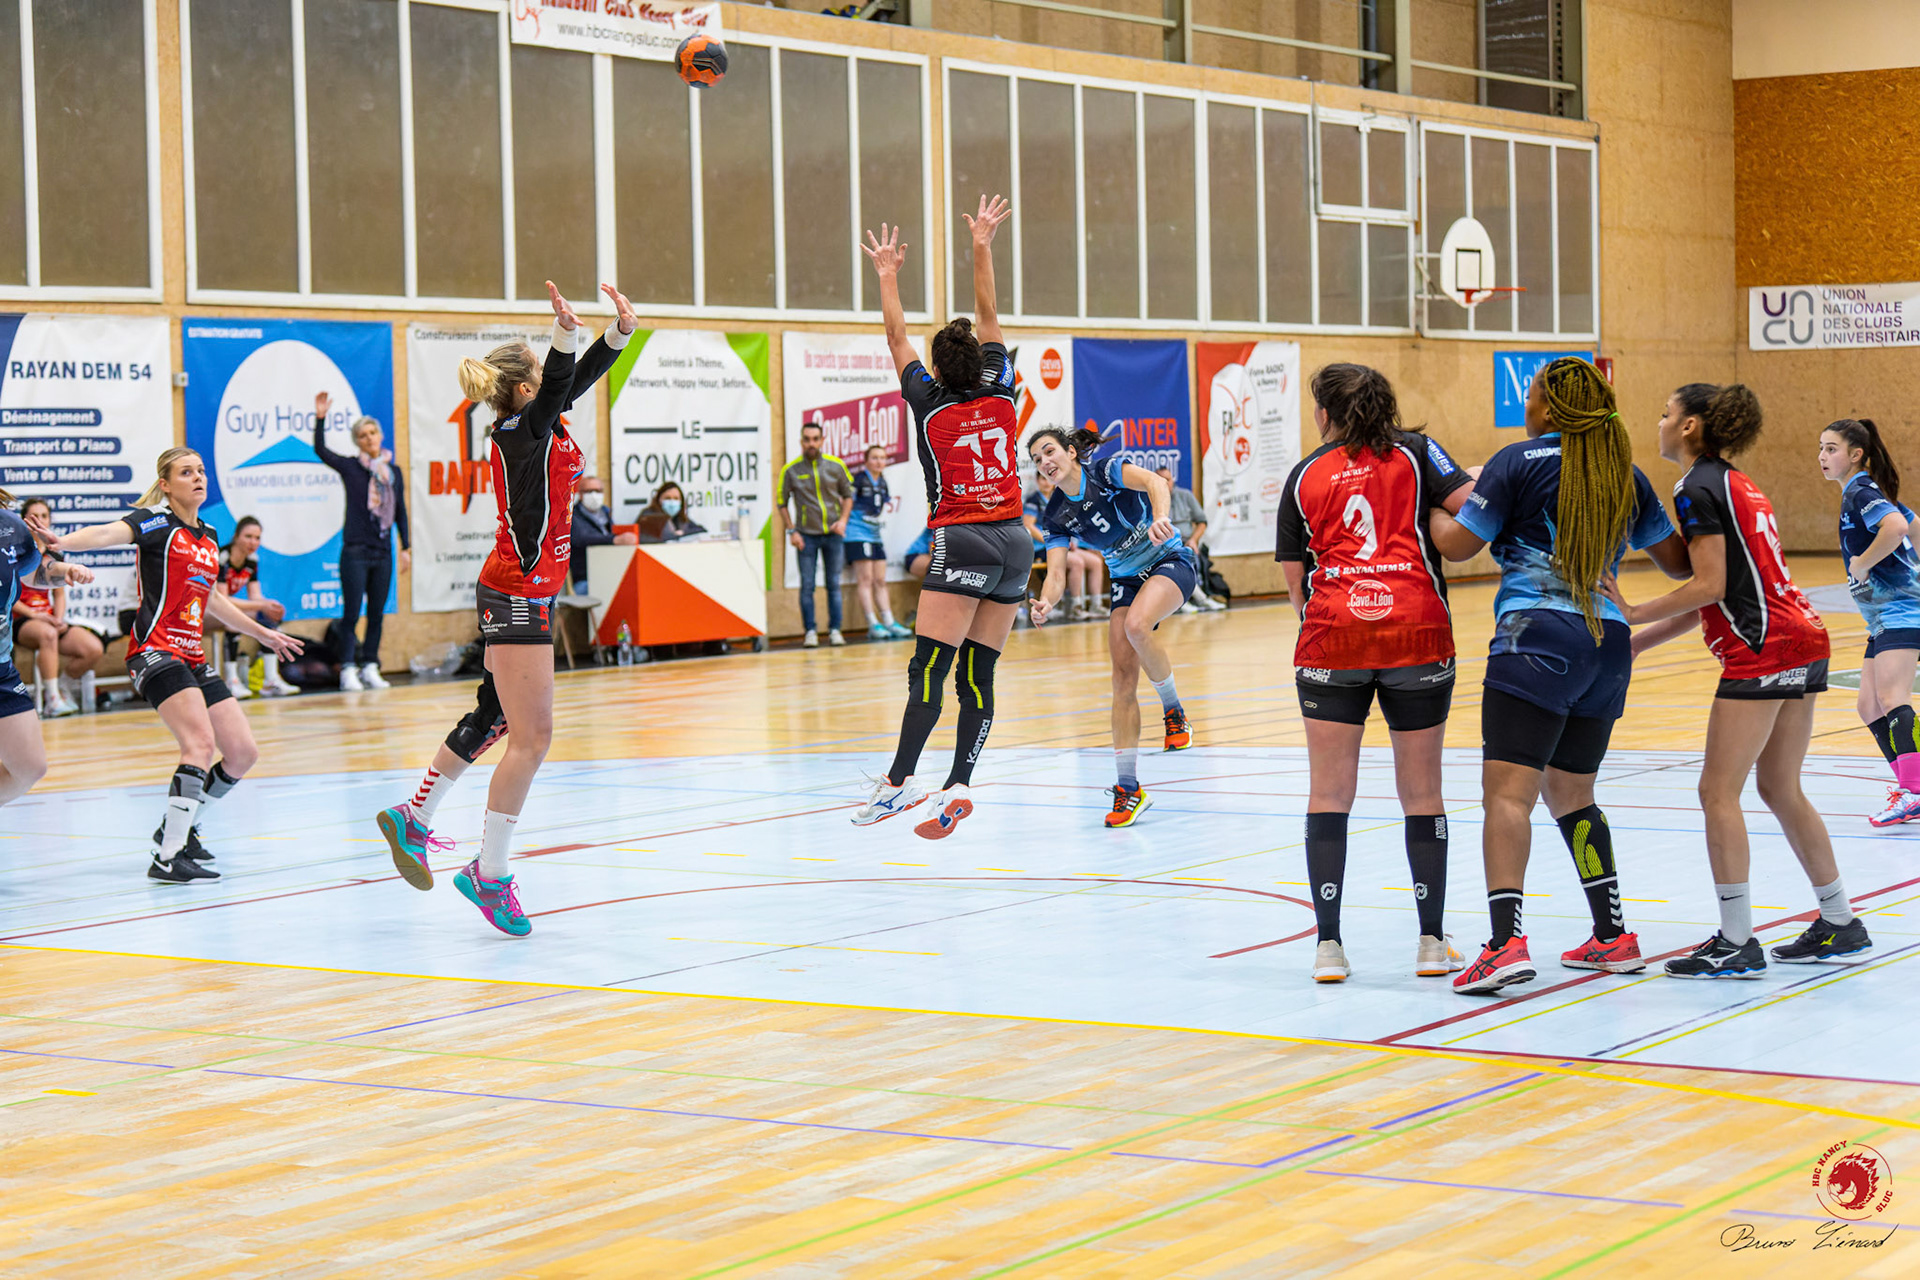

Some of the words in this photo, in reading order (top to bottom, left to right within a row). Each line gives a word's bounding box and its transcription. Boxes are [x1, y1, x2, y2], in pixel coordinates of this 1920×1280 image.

[1822, 289, 1867, 301] UNION
[1823, 302, 1903, 316] NATIONALE
[1823, 318, 1851, 330] DES
[1854, 316, 1903, 330] CLUBS
[11, 361, 76, 379] RAYAN
[82, 363, 122, 380] DEM
[129, 364, 152, 380] 54
[2, 411, 95, 426] Déménagement
[226, 404, 268, 439] Guy
[859, 397, 899, 451] Léon
[681, 420, 701, 439] LE
[1123, 418, 1178, 447] INTER
[3, 440, 61, 455] Transport
[62, 439, 77, 451] de
[79, 439, 115, 451] Piano
[953, 427, 1009, 482] 13
[4, 469, 39, 482] Vente
[41, 469, 56, 481] de
[58, 467, 114, 481] Matériels
[625, 452, 759, 485] COMPTOIR
[1341, 464, 1373, 478] BUREAU
[58, 496, 73, 509] de
[74, 495, 121, 509] Camion
[1091, 511, 1111, 533] 5
[1342, 493, 1378, 561] 9
[1342, 564, 1375, 575] RAYAN
[1376, 563, 1398, 574] DEM
[1398, 562, 1412, 572] 54
[960, 577, 985, 588] SPORT
[961, 571, 988, 582] INTER
[1350, 593, 1370, 607] Cave
[1374, 592, 1394, 606] Léon
[1302, 668, 1330, 683] SPORT
[1779, 668, 1807, 678] INTER
[1778, 676, 1806, 686] SPORT
[967, 719, 992, 764] Kempa
